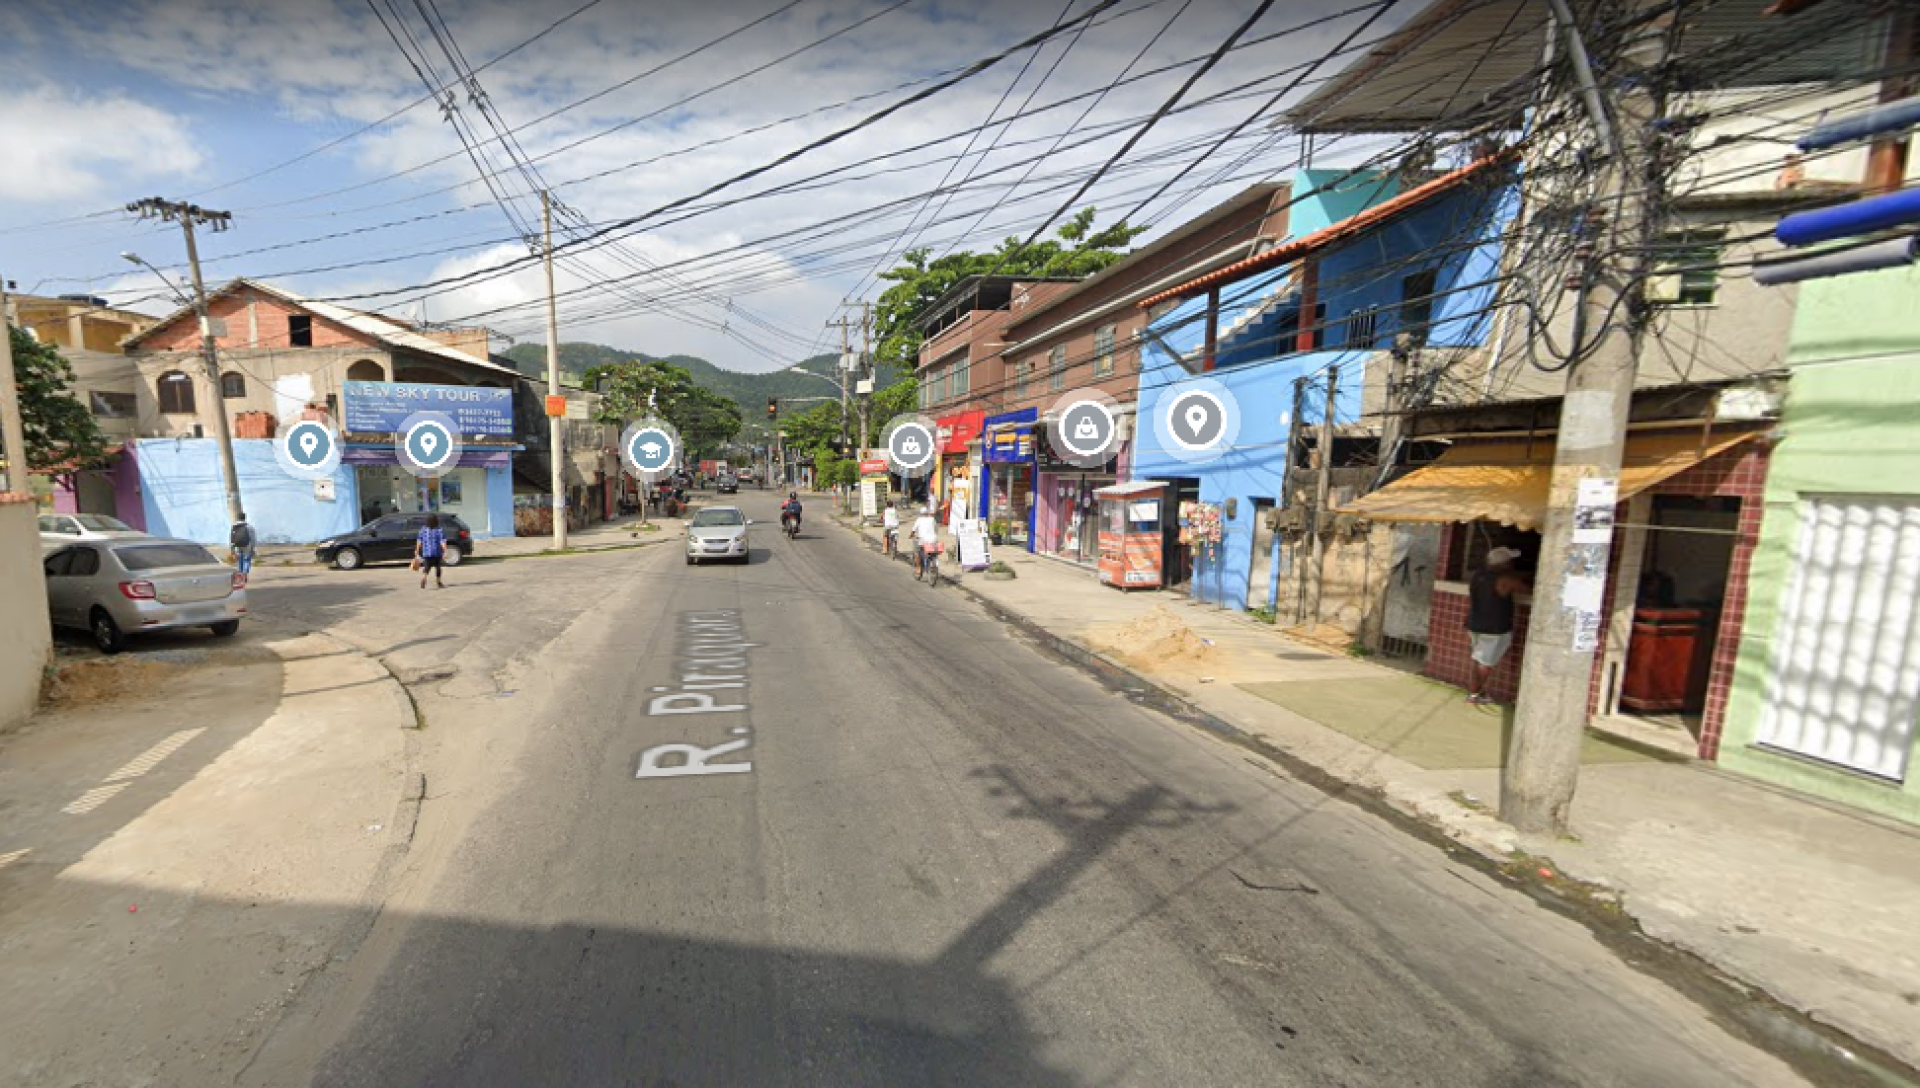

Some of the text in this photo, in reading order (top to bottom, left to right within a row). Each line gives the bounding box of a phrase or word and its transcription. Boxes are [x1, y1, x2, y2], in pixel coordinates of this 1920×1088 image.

[348, 385, 480, 401] NEW SKY TOUR
